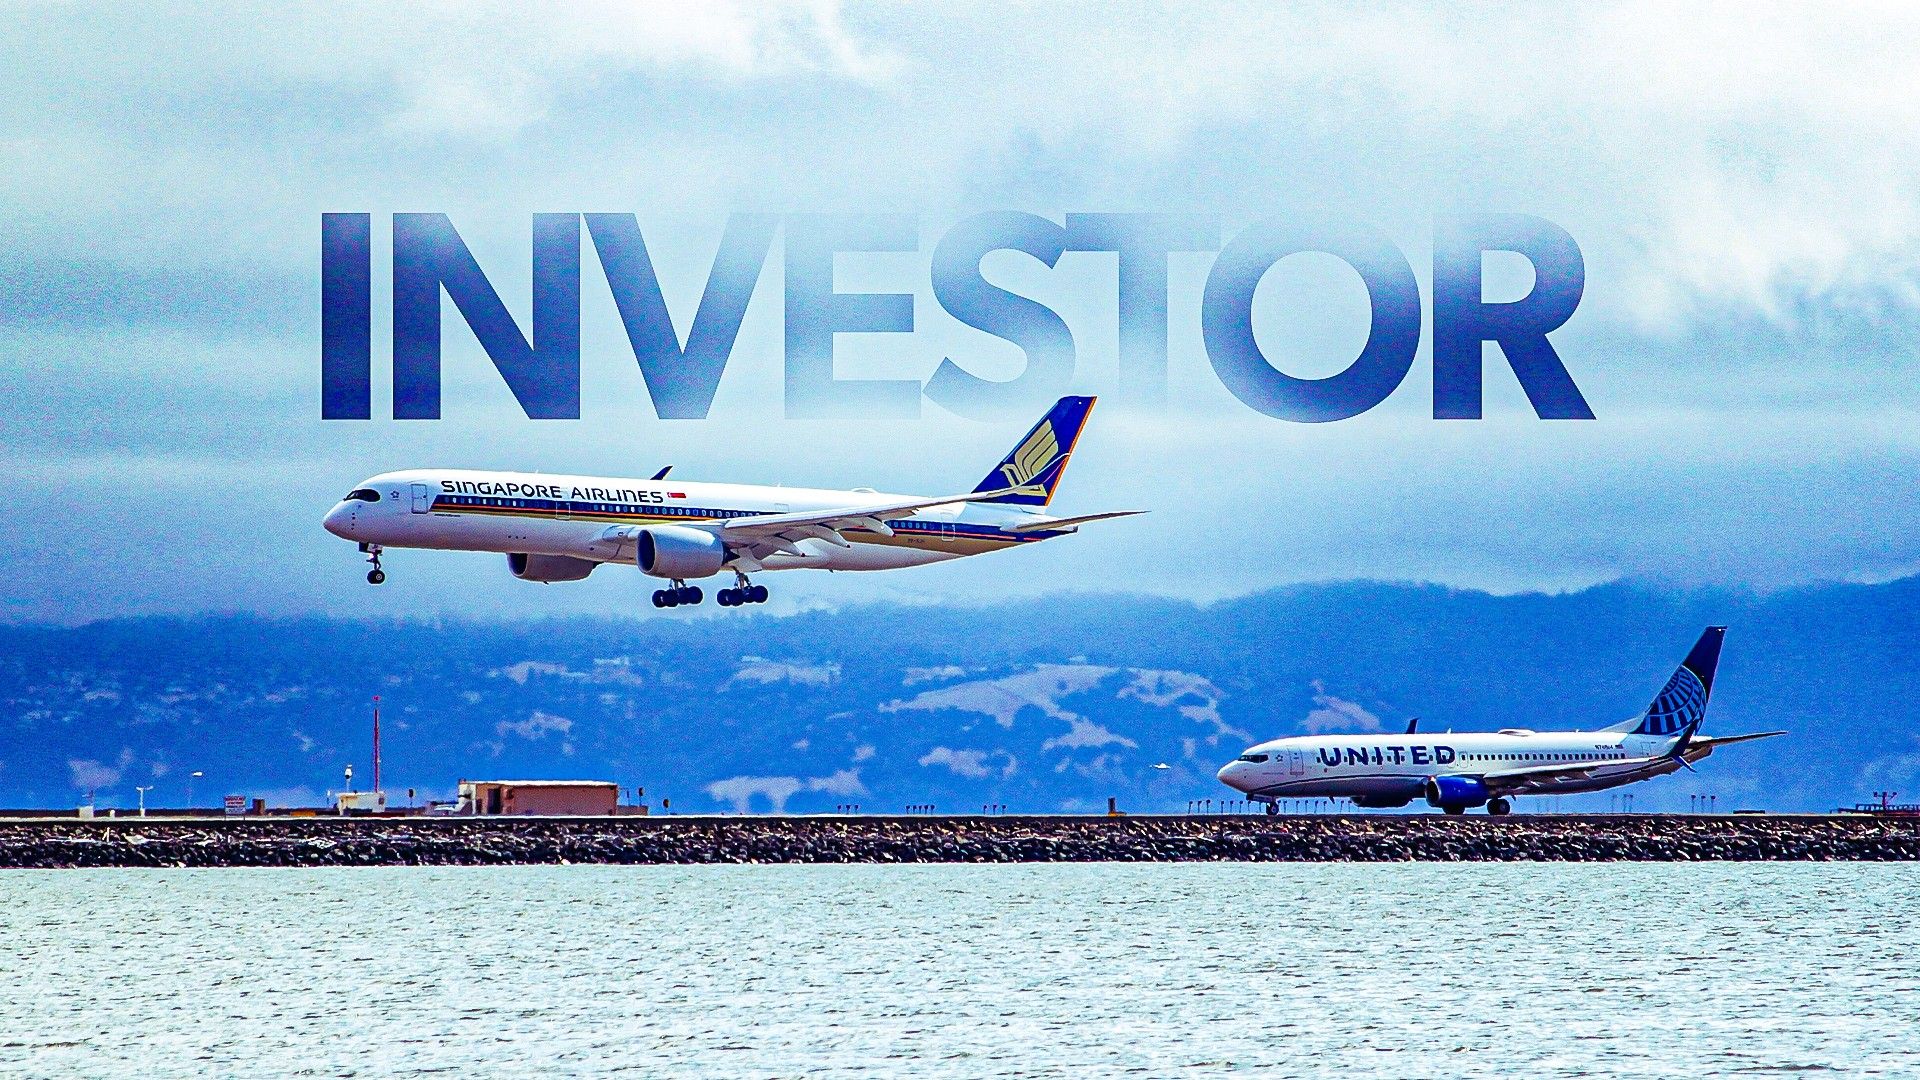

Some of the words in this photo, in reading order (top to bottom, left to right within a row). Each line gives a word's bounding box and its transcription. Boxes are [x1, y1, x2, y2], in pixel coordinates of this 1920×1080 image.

[441, 480, 562, 498] SINGAPORE
[571, 486, 664, 503] AIRLINES
[1319, 745, 1456, 767] UNITED
